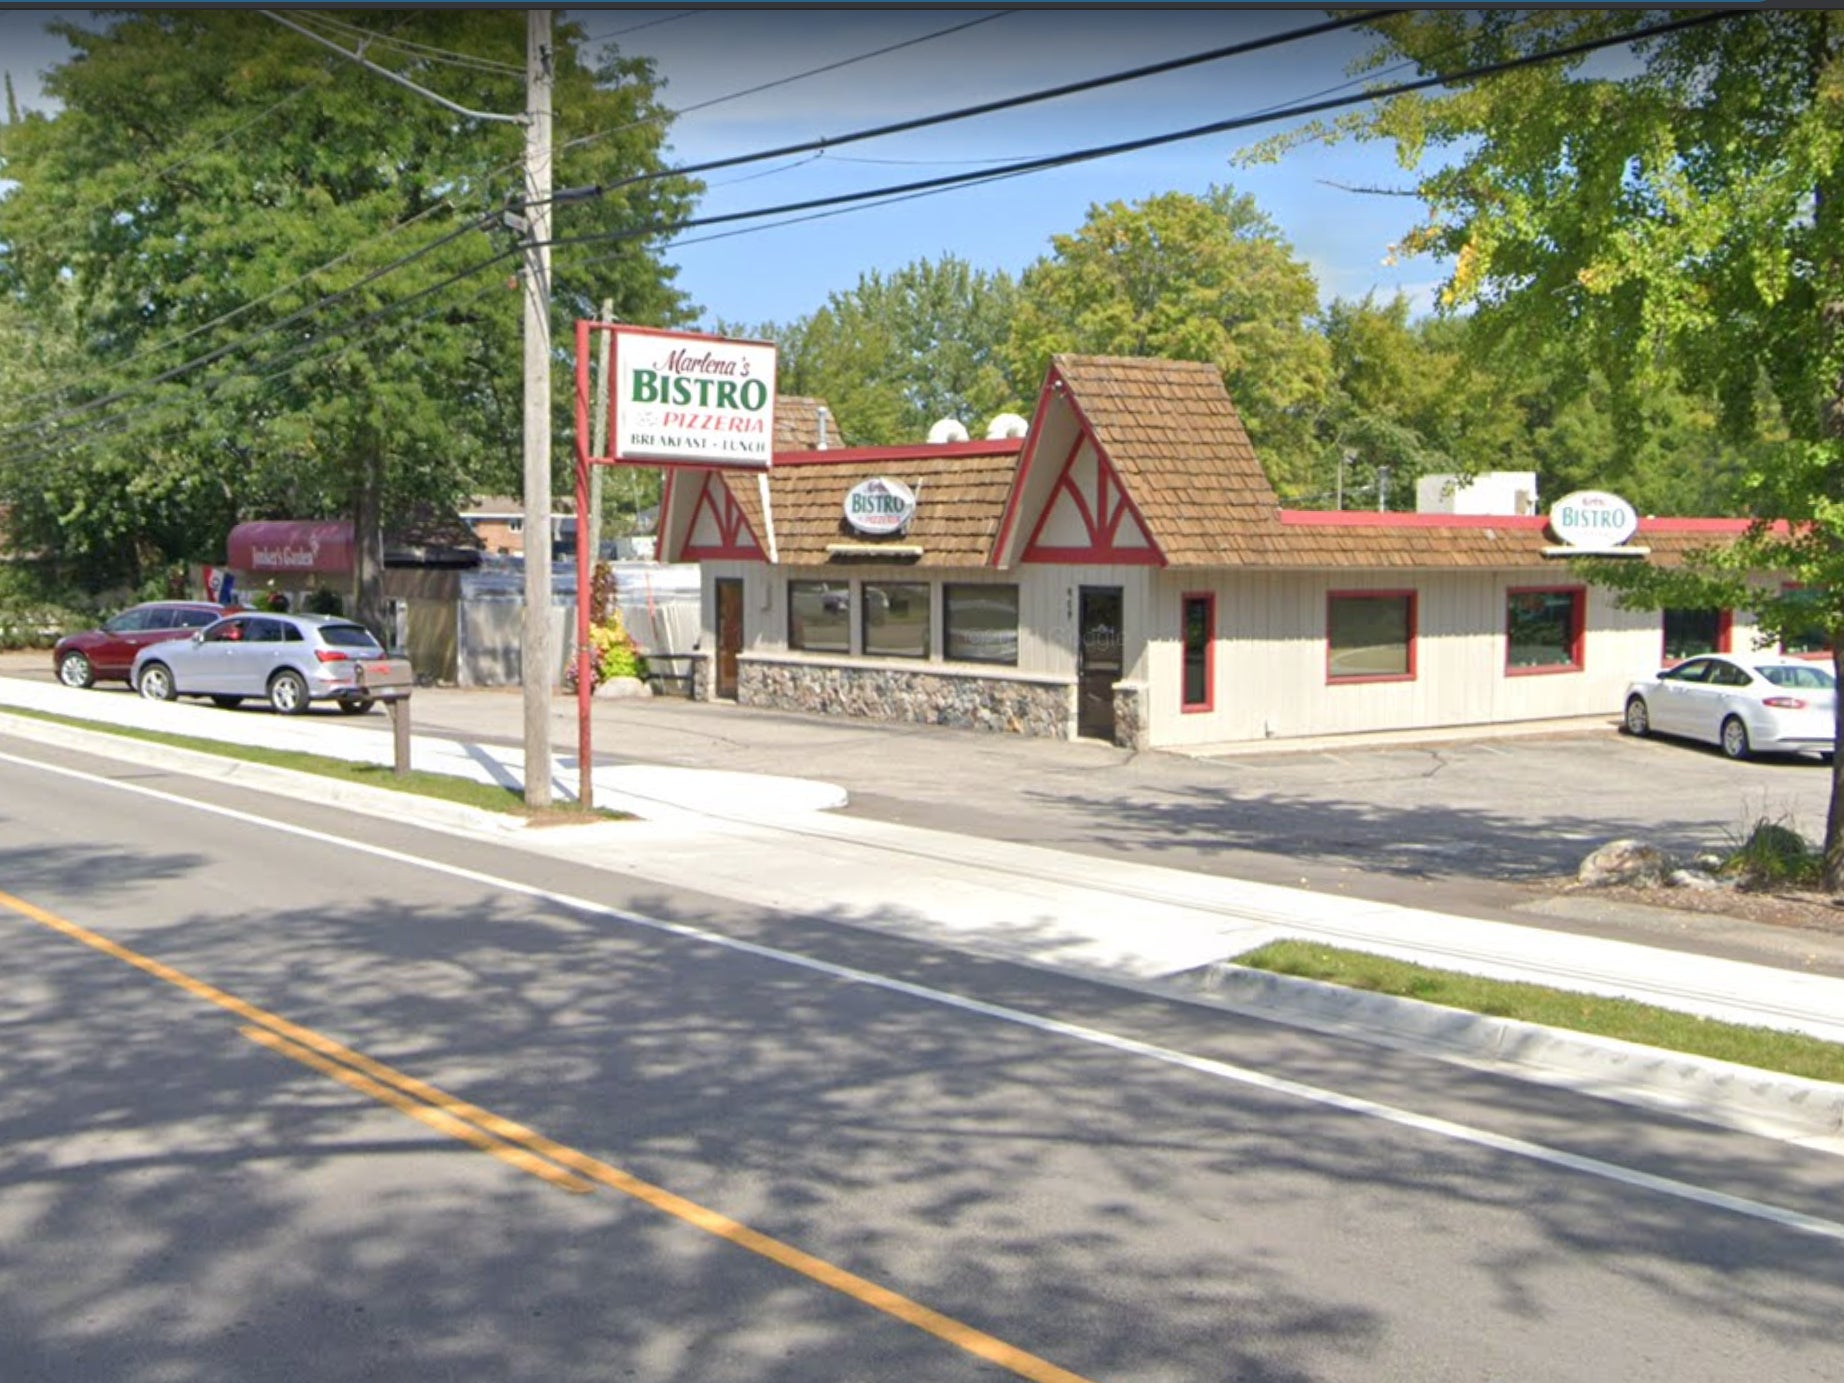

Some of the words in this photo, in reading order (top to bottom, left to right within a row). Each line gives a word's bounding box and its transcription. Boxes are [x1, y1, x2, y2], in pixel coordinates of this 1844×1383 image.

[653, 348, 750, 377] Marlena's
[631, 368, 767, 412] BISTRO
[664, 412, 764, 433] PIZZERIA
[631, 433, 707, 449] BREAKFAST
[723, 438, 765, 453] LUNCH
[852, 493, 905, 513] BISTRO
[1562, 507, 1626, 528] BISTRO
